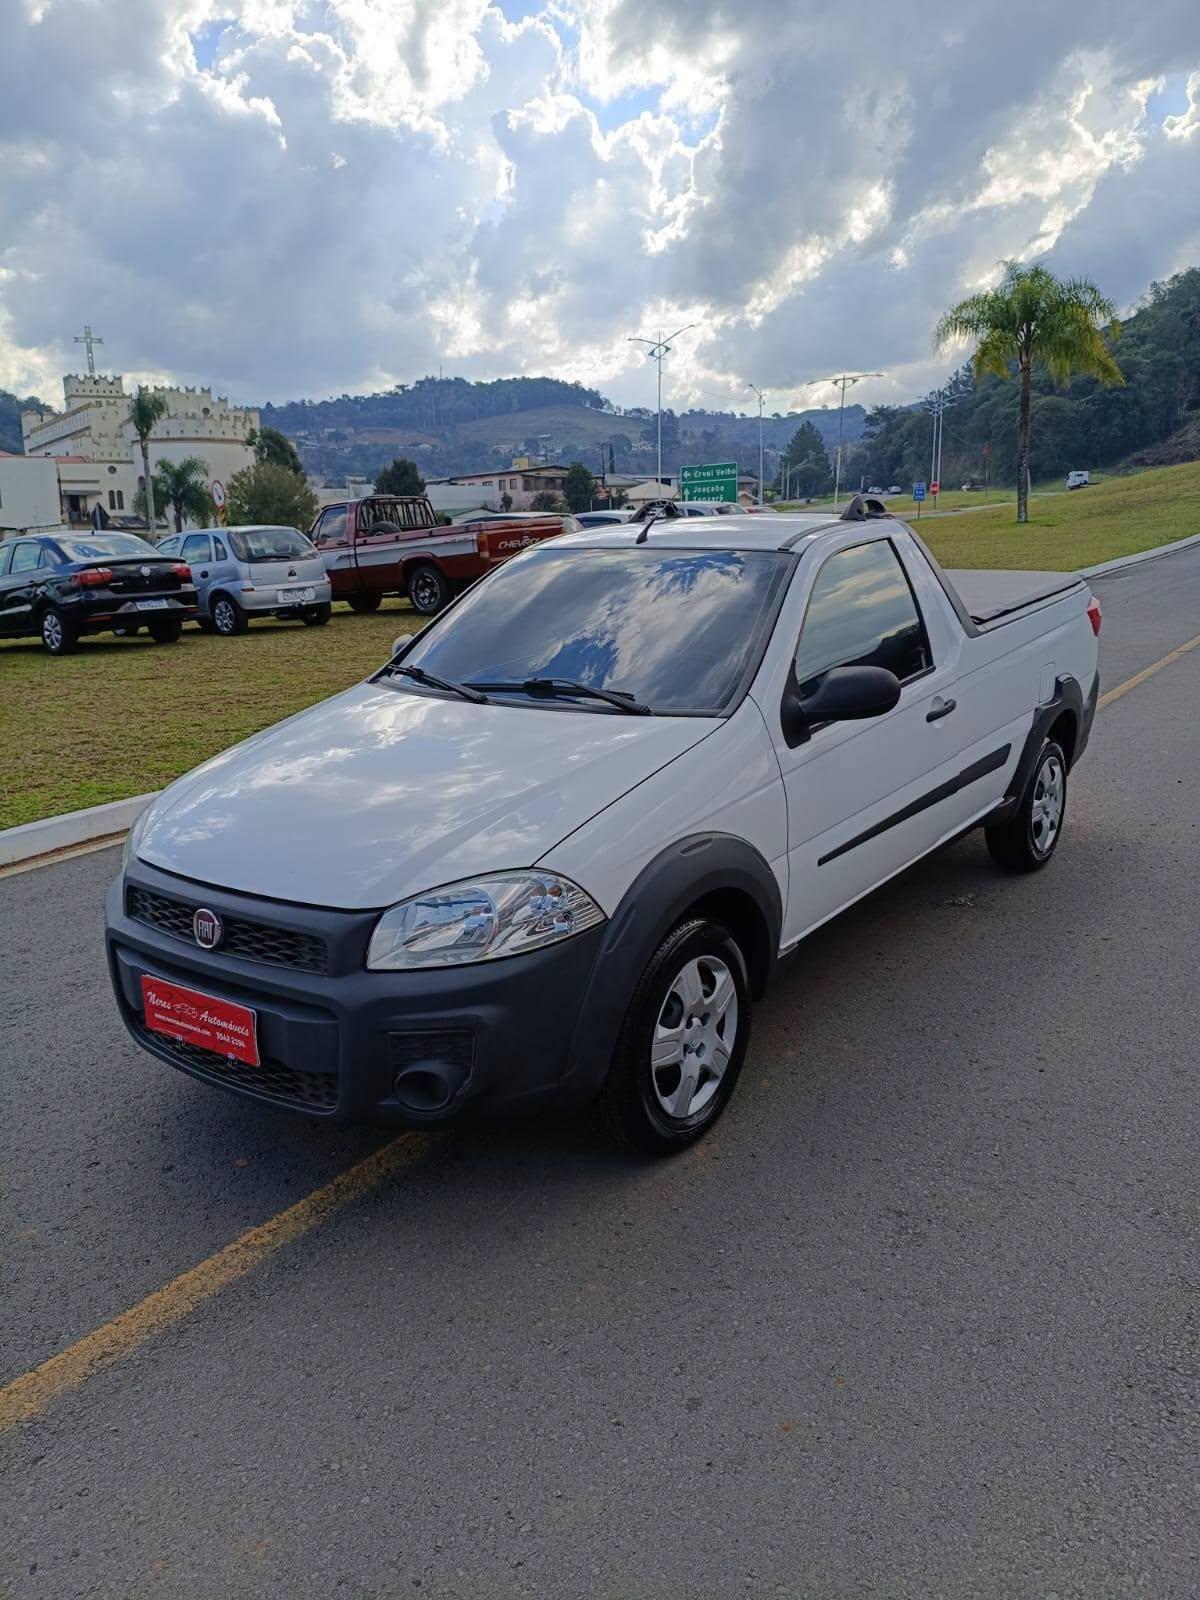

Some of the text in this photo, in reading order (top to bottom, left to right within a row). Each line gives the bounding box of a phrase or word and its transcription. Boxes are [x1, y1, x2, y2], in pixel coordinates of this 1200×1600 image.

[693, 467, 737, 478] Erval Velho
[692, 485, 725, 494] Joaçaba
[198, 919, 214, 940] FIAT
[147, 991, 172, 1010] Neres
[199, 1010, 249, 1037] Automóveis
